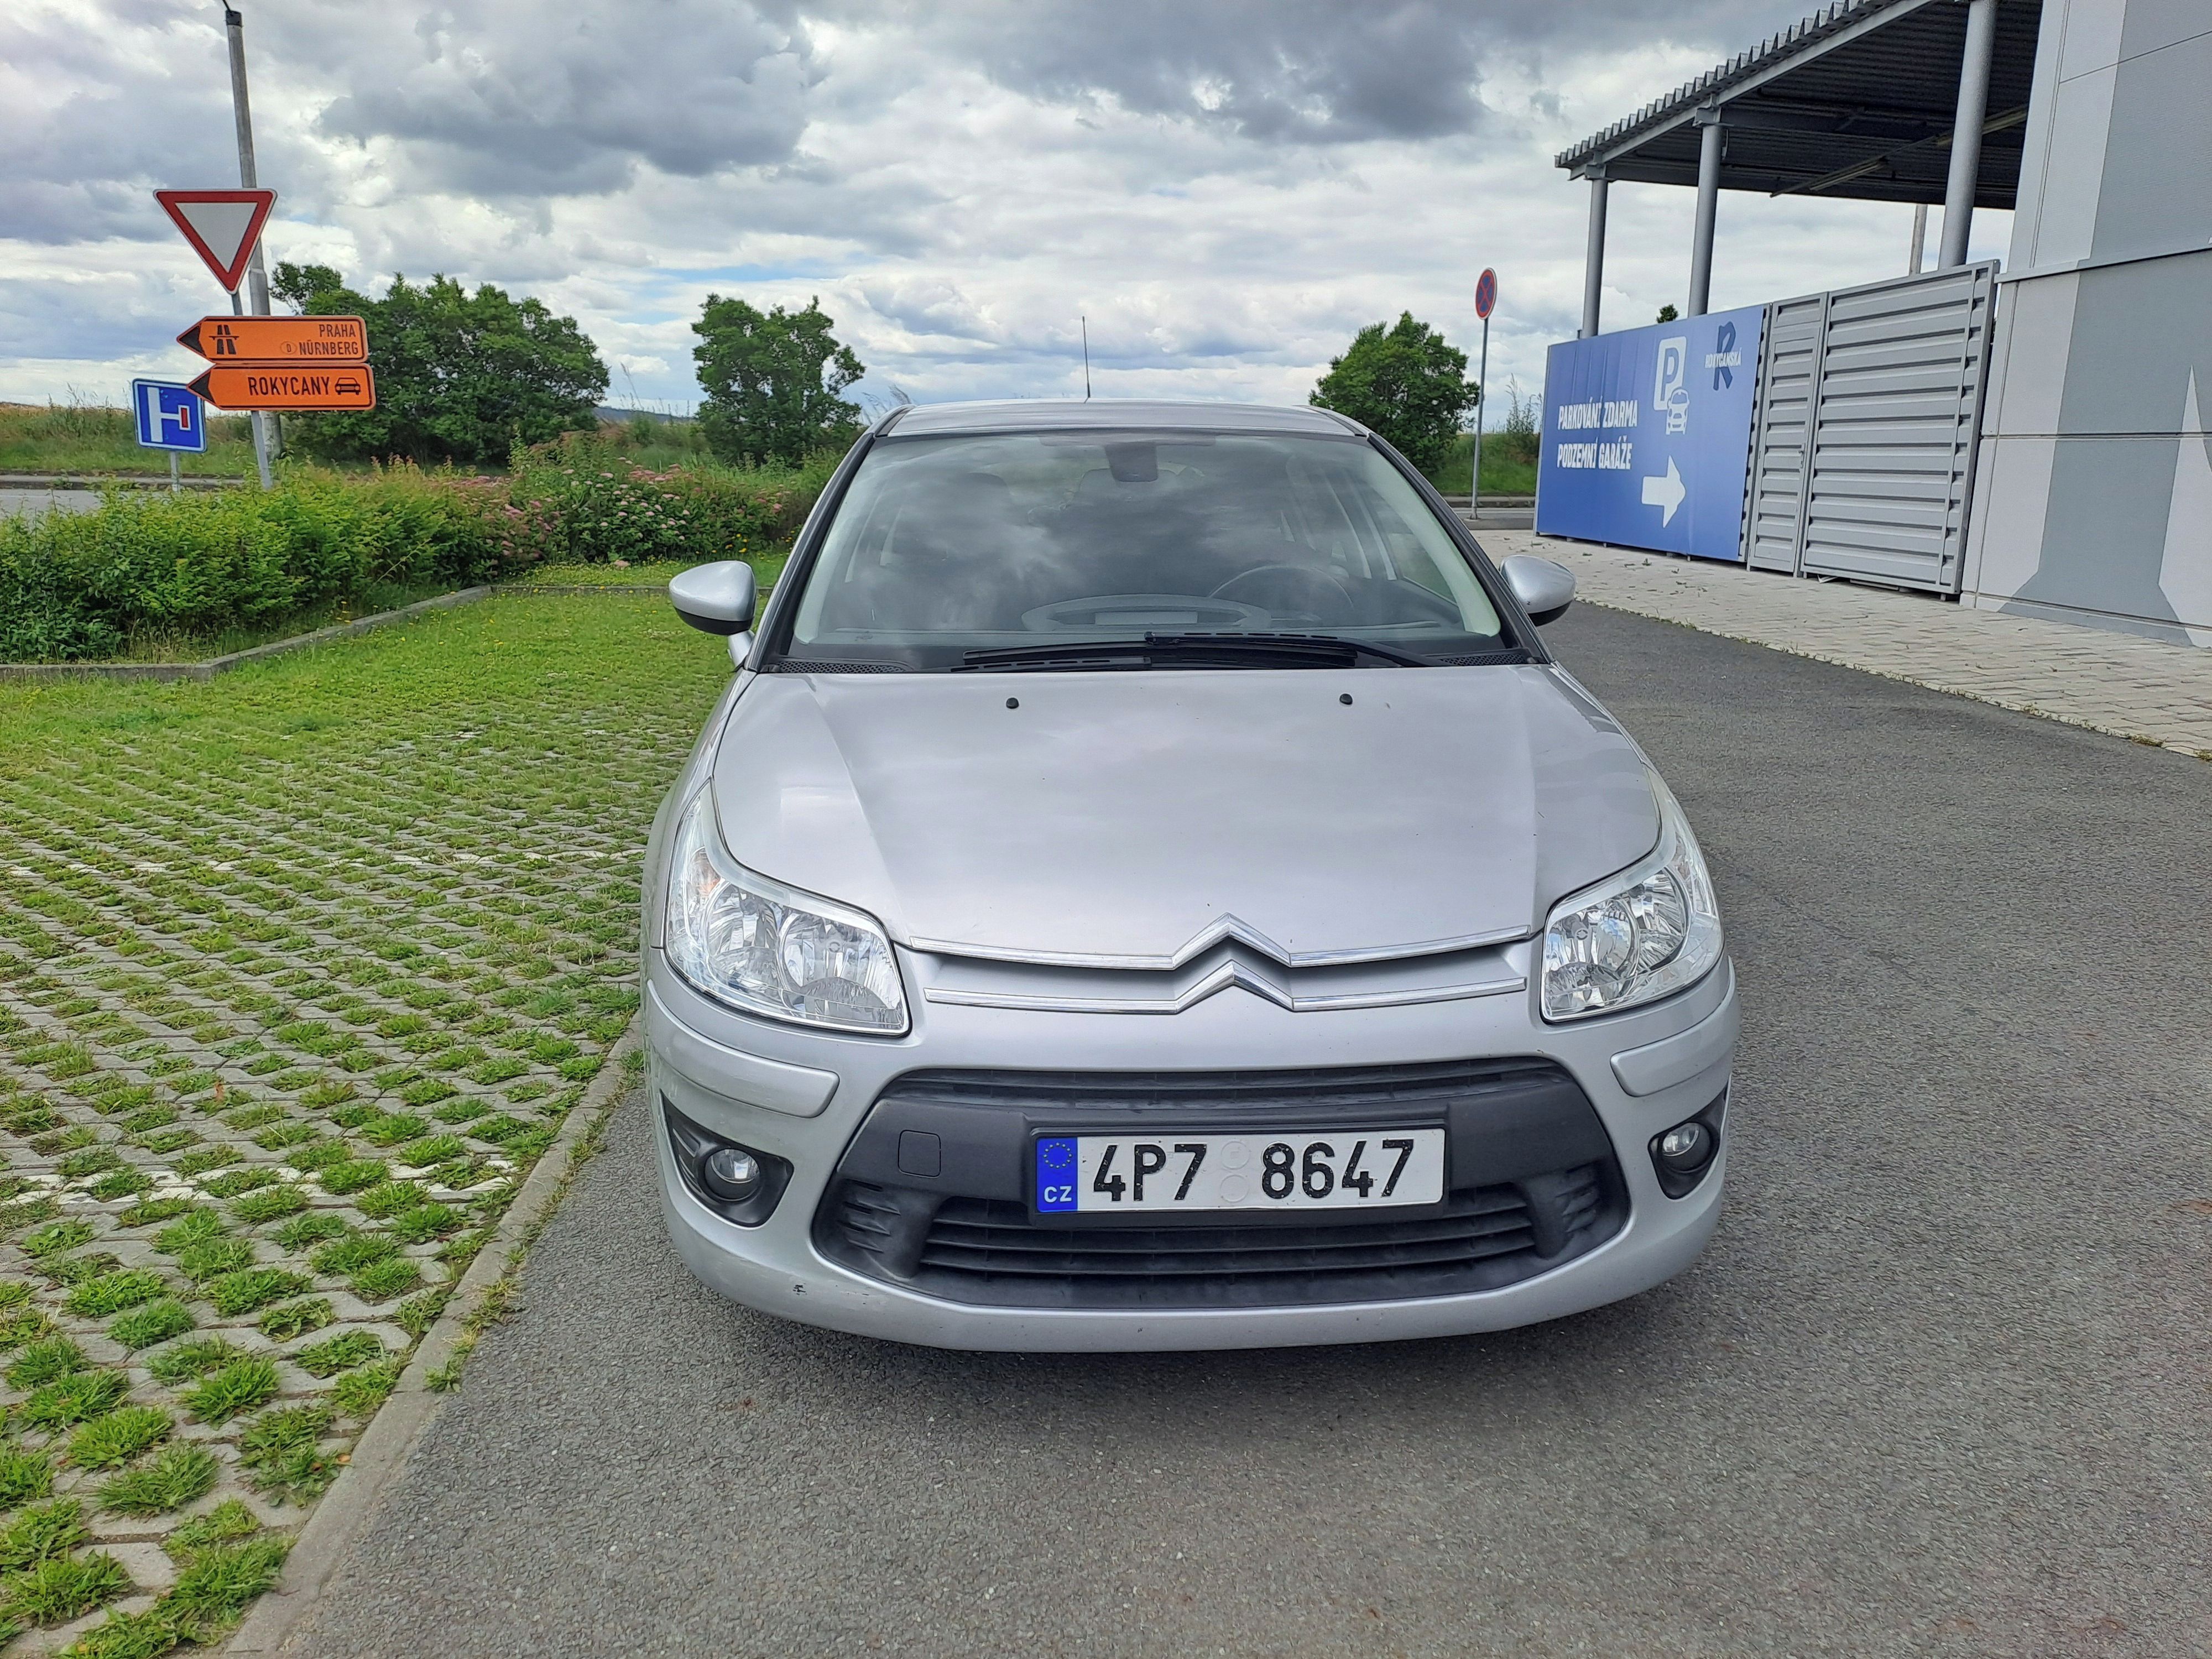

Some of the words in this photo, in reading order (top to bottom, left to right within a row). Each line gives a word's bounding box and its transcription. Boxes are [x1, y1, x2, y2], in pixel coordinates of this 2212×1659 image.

[319, 324, 356, 337] PRAHA
[299, 340, 358, 355] NÜRNBERG
[248, 377, 330, 395] ROKYCANY
[1558, 395, 1603, 430] PARKOVÁNÍ
[1603, 400, 1637, 428] ZDARMA
[1557, 437, 1598, 468] PODZEMNÍ
[1599, 435, 1632, 469] GARÁŽE
[1093, 1144, 1207, 1202] 4P7
[1262, 1139, 1414, 1199] 8647
[1044, 1186, 1072, 1203] CZ
